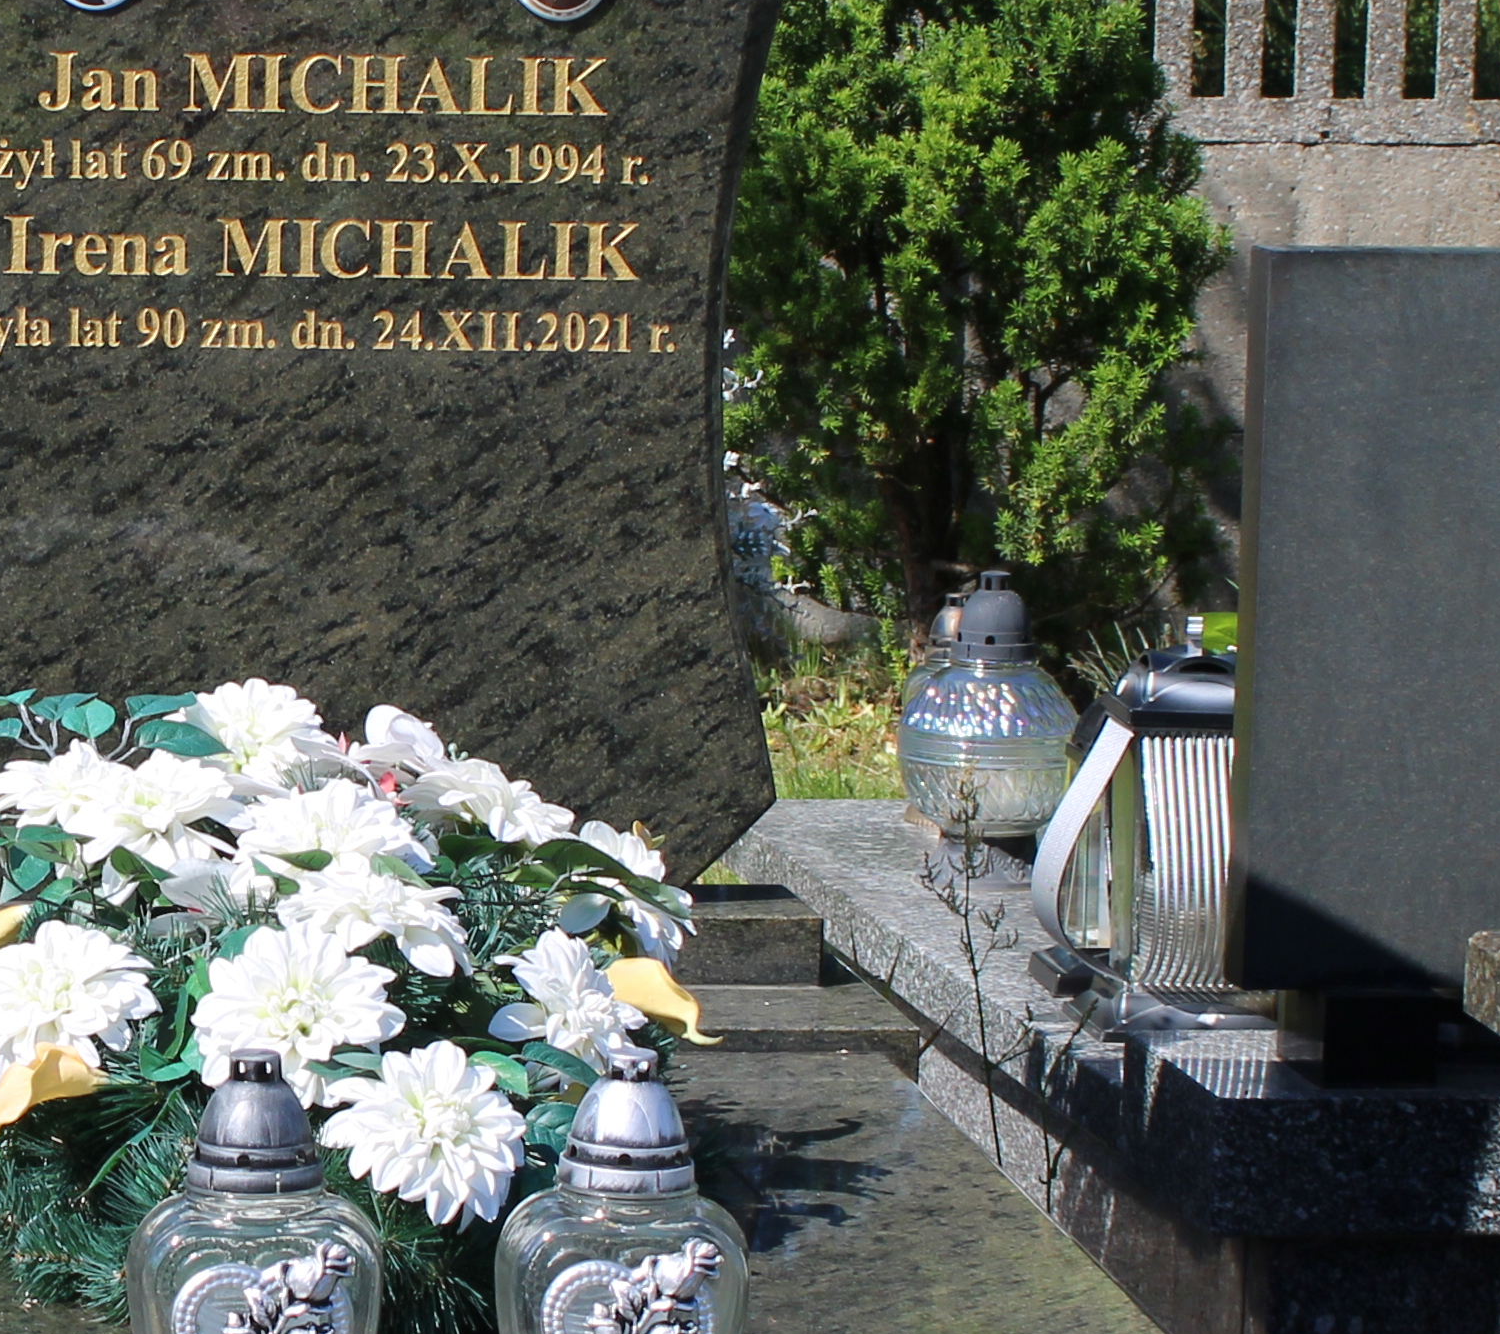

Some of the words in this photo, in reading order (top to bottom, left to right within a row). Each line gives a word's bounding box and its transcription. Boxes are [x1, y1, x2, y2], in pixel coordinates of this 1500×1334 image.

[38, 51, 161, 112] Jan
[183, 54, 608, 115] MICHALIK
[70, 140, 127, 181] lat
[142, 140, 193, 180] 69
[206, 150, 284, 182] zm.
[301, 144, 370, 183] dn.
[385, 144, 605, 185] 23.X.1994
[621, 155, 649, 185] r.
[2, 215, 189, 276] Irena
[216, 219, 640, 281] MICHALIK
[69, 308, 122, 347] lat
[137, 309, 188, 349] 90
[202, 319, 276, 350] zm.
[293, 311, 355, 351] dn.
[372, 312, 632, 353] 24.XII.2021
[649, 322, 677, 352] r.
